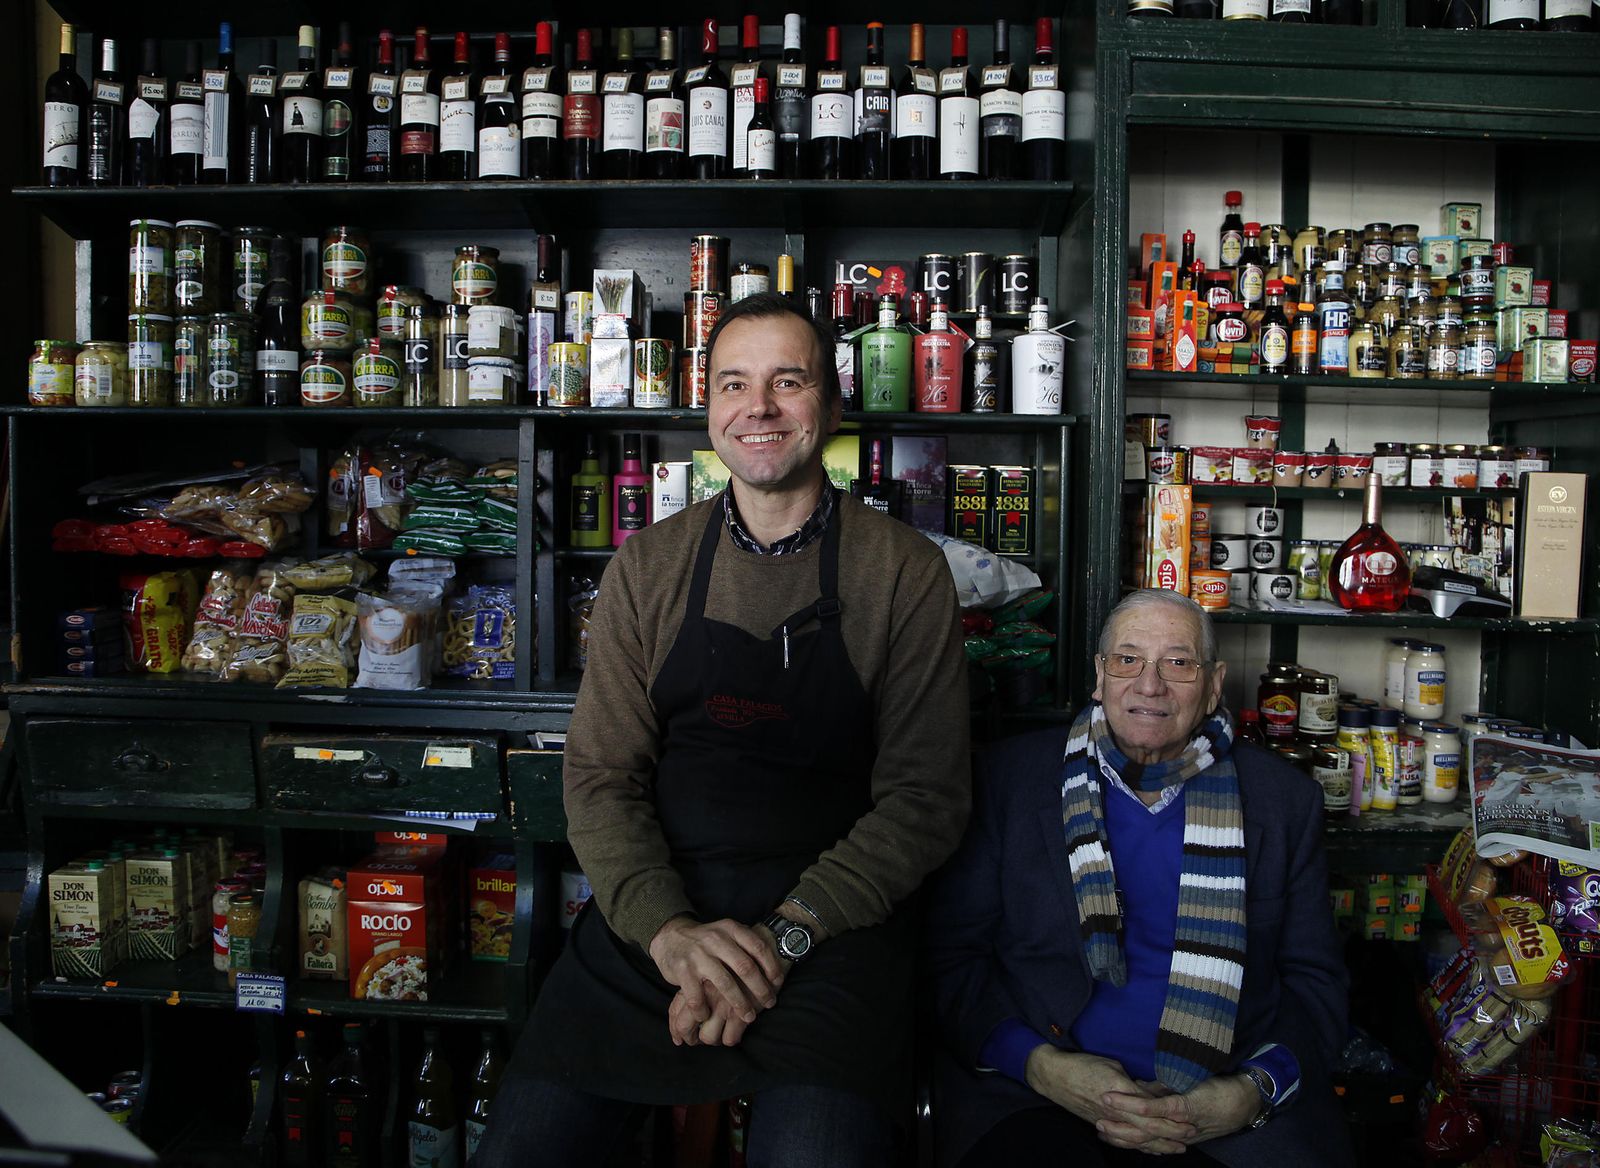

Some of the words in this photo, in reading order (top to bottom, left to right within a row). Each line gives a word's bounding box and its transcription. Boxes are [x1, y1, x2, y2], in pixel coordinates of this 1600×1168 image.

[866, 95, 889, 111] CAIR
[923, 271, 951, 292] LC
[1002, 271, 1029, 293] LC
[1325, 311, 1349, 327] HP
[405, 343, 429, 364] LC
[953, 495, 988, 511] 1881
[995, 495, 1030, 511] 1881
[1205, 582, 1225, 593] apis
[147, 628, 162, 669] GRATIS
[1508, 813, 1540, 821] FINAL
[138, 867, 160, 875] DON
[63, 882, 85, 890] DON
[130, 875, 169, 886] SIMON
[53, 890, 95, 902] SIMON
[360, 913, 412, 931] ROCÍO
[307, 955, 334, 969] Fallera
